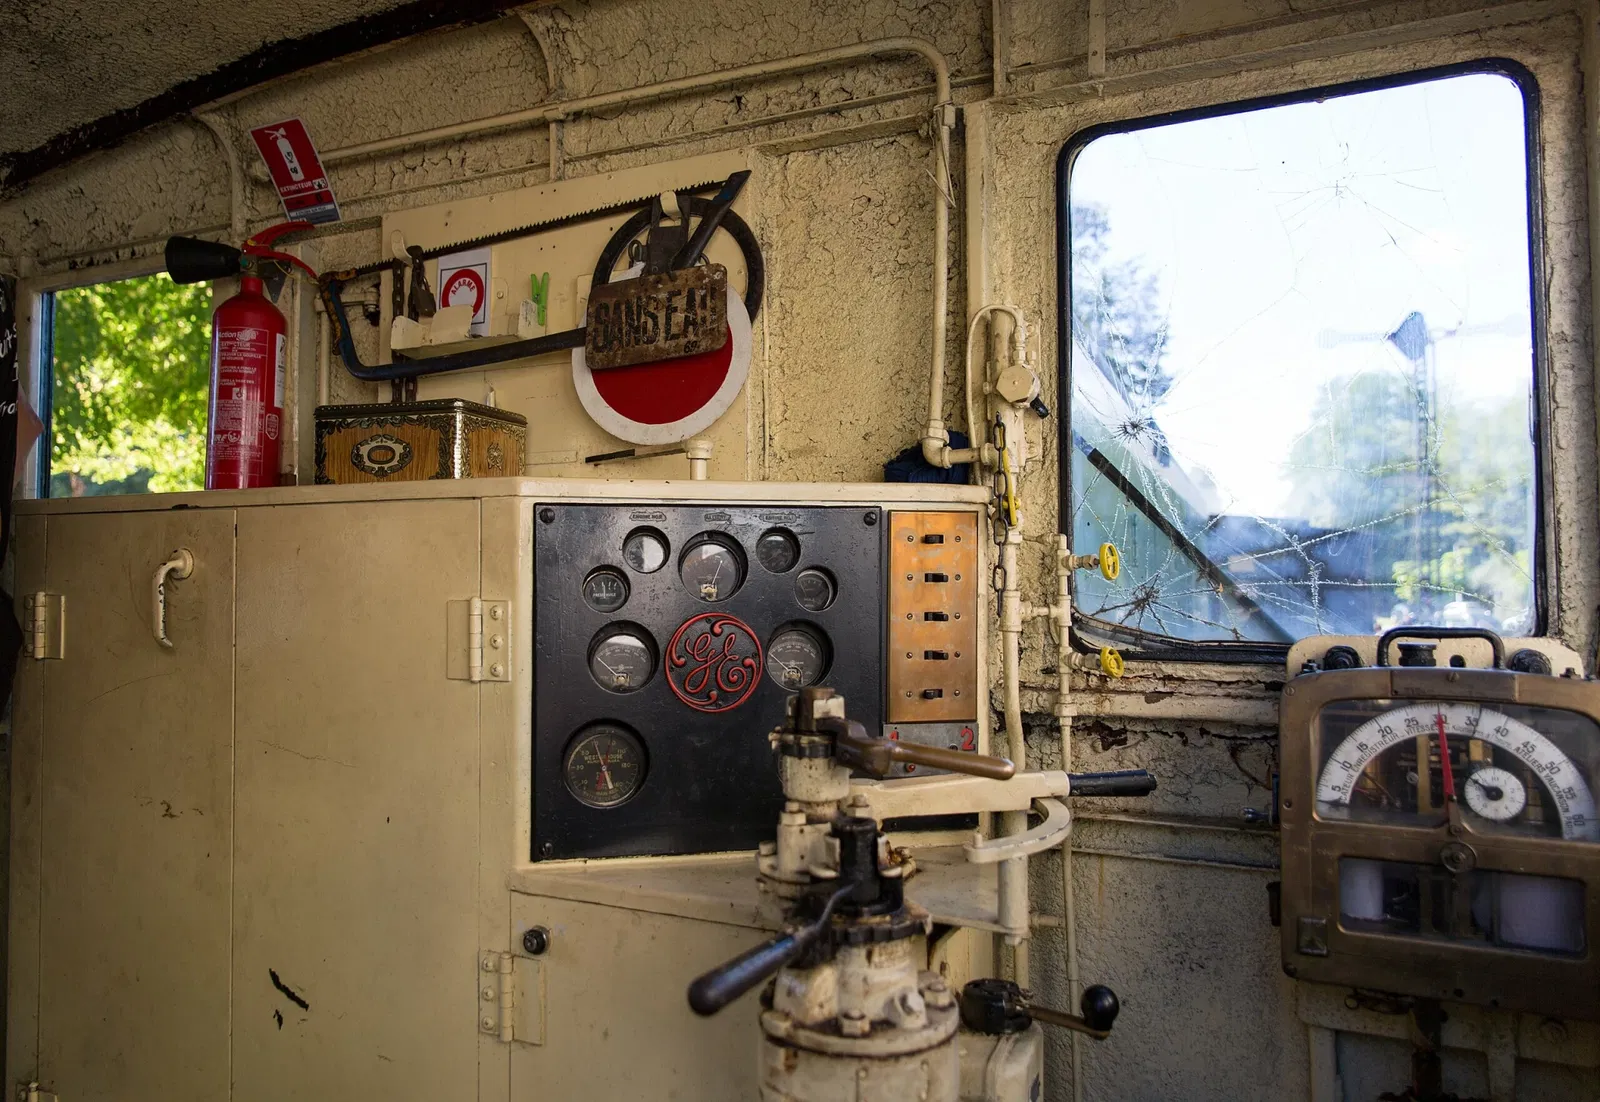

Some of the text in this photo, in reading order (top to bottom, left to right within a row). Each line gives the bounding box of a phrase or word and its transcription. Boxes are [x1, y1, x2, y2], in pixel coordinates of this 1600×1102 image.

[280, 181, 313, 192] EXTINCTEUR
[451, 279, 476, 295] ALARME
[592, 295, 659, 353] SANS
[960, 727, 976, 751] 2
[584, 753, 624, 761] WESTOUSE
[1351, 732, 1400, 773] ENREGISTREUR
[1513, 746, 1546, 773] ATELIERS
[1331, 784, 1342, 793] 5
[1340, 760, 1353, 773] 10
[1356, 741, 1369, 753] 15
[1377, 725, 1393, 738] 20
[1404, 717, 1419, 728] 25
[1432, 713, 1448, 725] 30
[1493, 725, 1509, 738] 40
[1521, 740, 1537, 754] 45
[1544, 760, 1561, 775] 50
[1562, 786, 1578, 801] 55
[1572, 813, 1586, 828] 60
